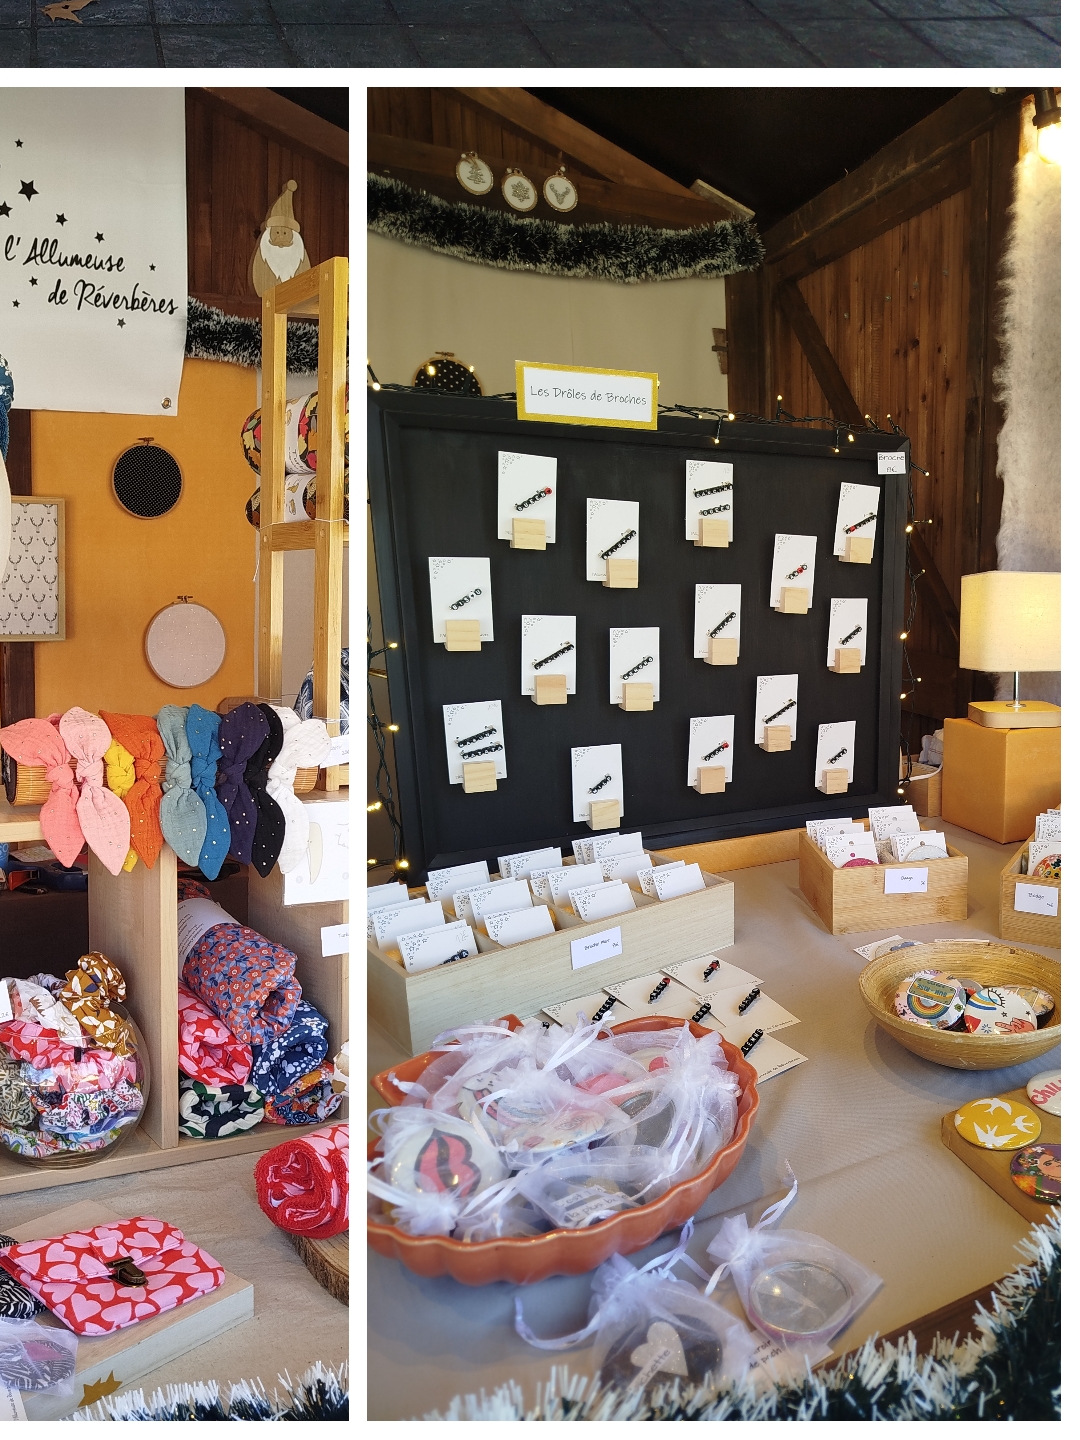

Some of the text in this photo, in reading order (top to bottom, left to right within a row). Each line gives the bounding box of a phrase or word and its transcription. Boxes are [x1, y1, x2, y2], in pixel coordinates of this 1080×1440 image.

[47, 278, 178, 316] de Réverbères
[530, 385, 647, 406] Les Drôles de Broches
